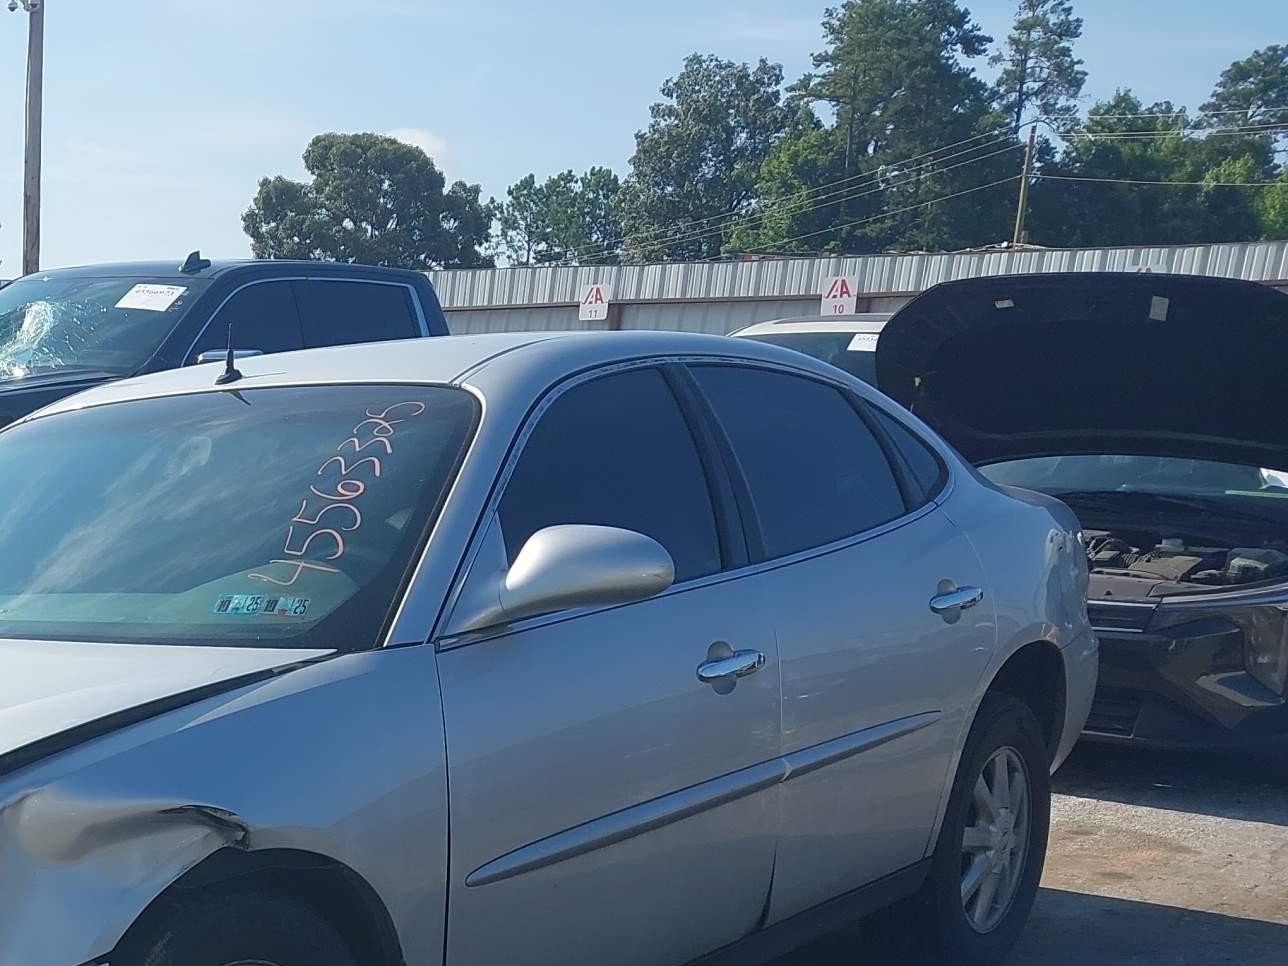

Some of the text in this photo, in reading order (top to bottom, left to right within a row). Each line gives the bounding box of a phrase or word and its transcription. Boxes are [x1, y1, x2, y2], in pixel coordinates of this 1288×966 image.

[588, 309, 599, 319] 11
[833, 304, 845, 314] 10
[246, 596, 262, 612] 25
[292, 599, 309, 615] 25
